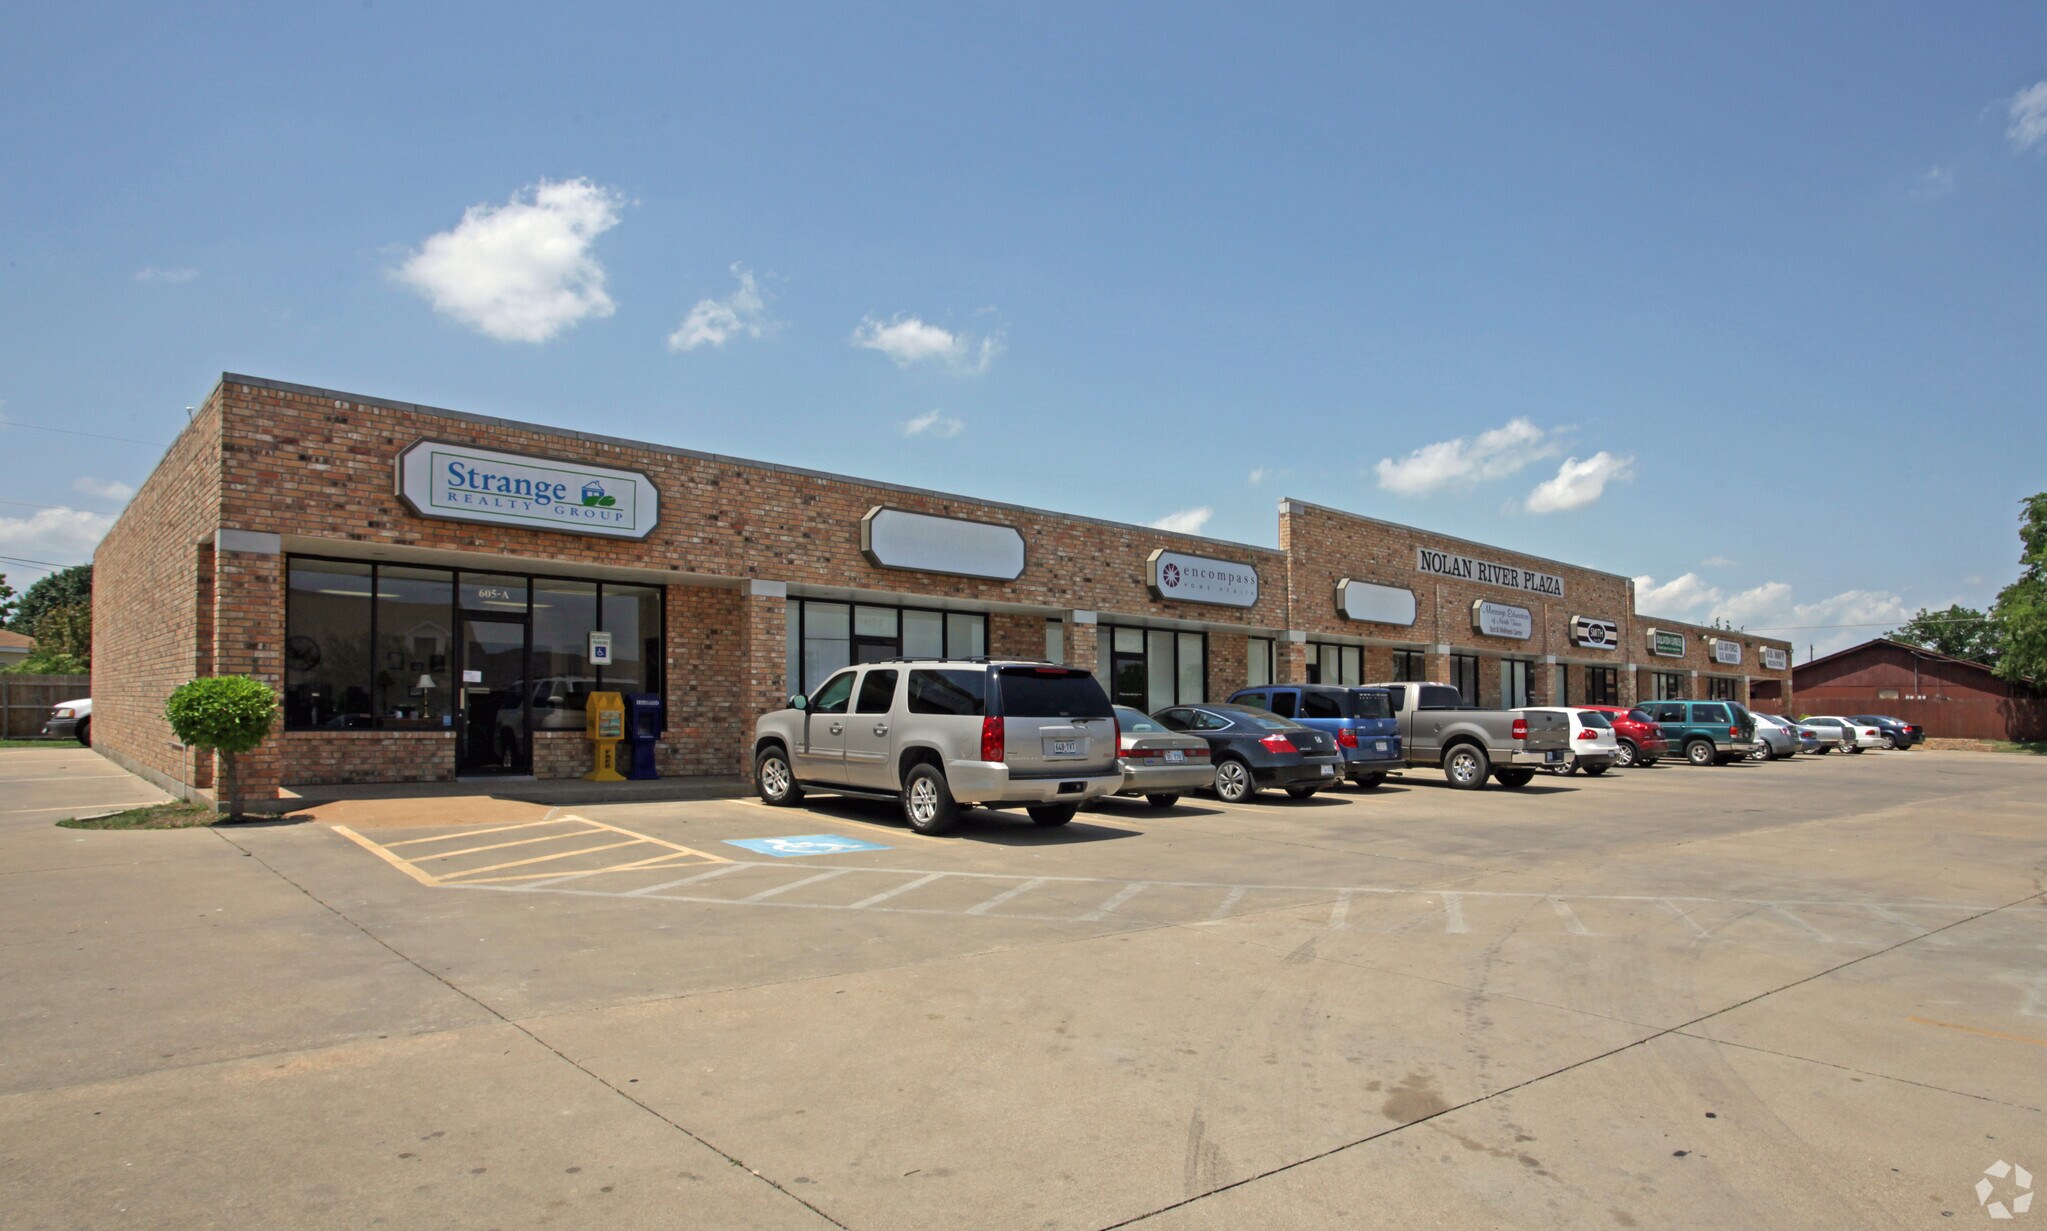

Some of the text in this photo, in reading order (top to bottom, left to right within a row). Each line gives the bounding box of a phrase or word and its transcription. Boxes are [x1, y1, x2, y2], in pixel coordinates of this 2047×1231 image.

[447, 461, 567, 505] Strange
[447, 491, 624, 522] REALTY GROUP
[1183, 566, 1255, 586] encompass
[1420, 550, 1562, 596] NOLAN RIVER PLAZA
[478, 588, 510, 600] 605-A
[1590, 627, 1604, 639] SMITH
